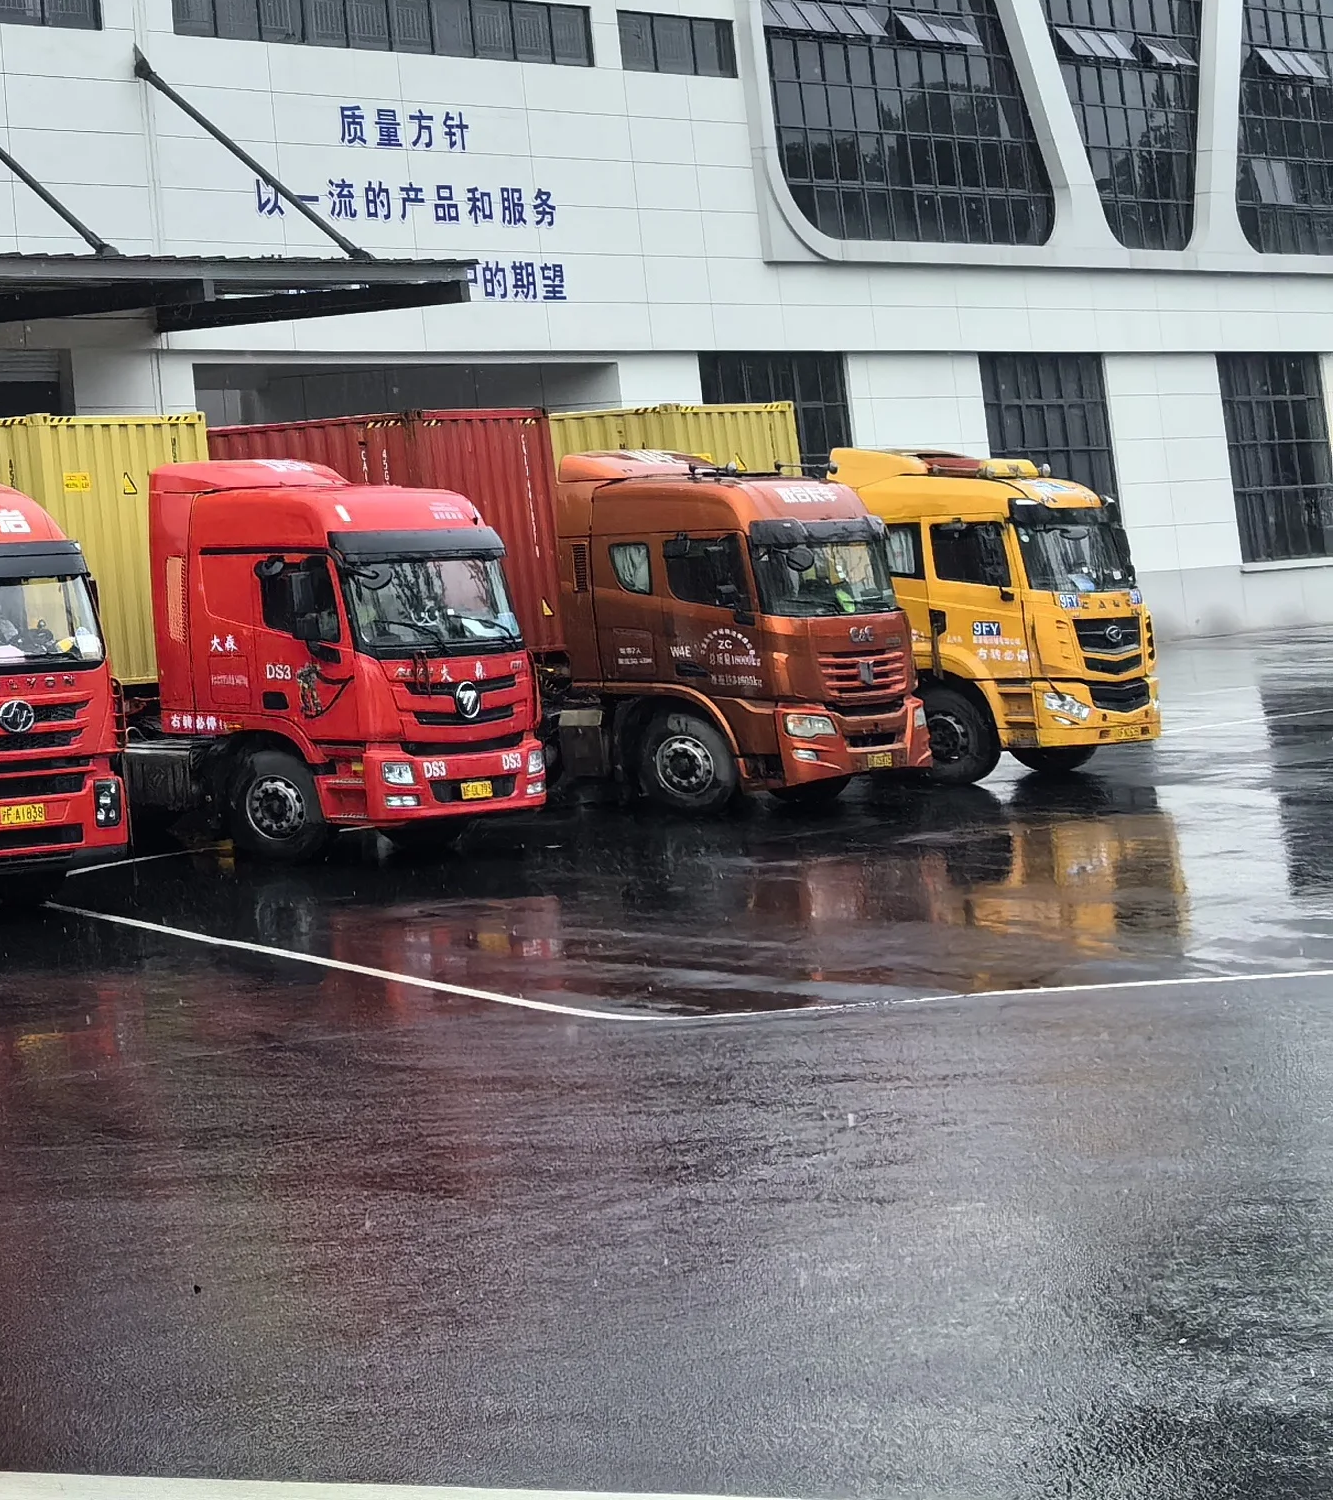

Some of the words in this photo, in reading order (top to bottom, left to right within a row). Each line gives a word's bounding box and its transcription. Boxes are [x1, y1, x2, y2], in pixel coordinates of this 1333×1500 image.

[339, 105, 470, 151] 质量方针
[254, 178, 558, 227] 以一流的产品和服务
[973, 622, 999, 635] 9FY
[265, 663, 292, 680] DS3
[422, 761, 447, 779] DS3
[502, 752, 523, 771] DS3
